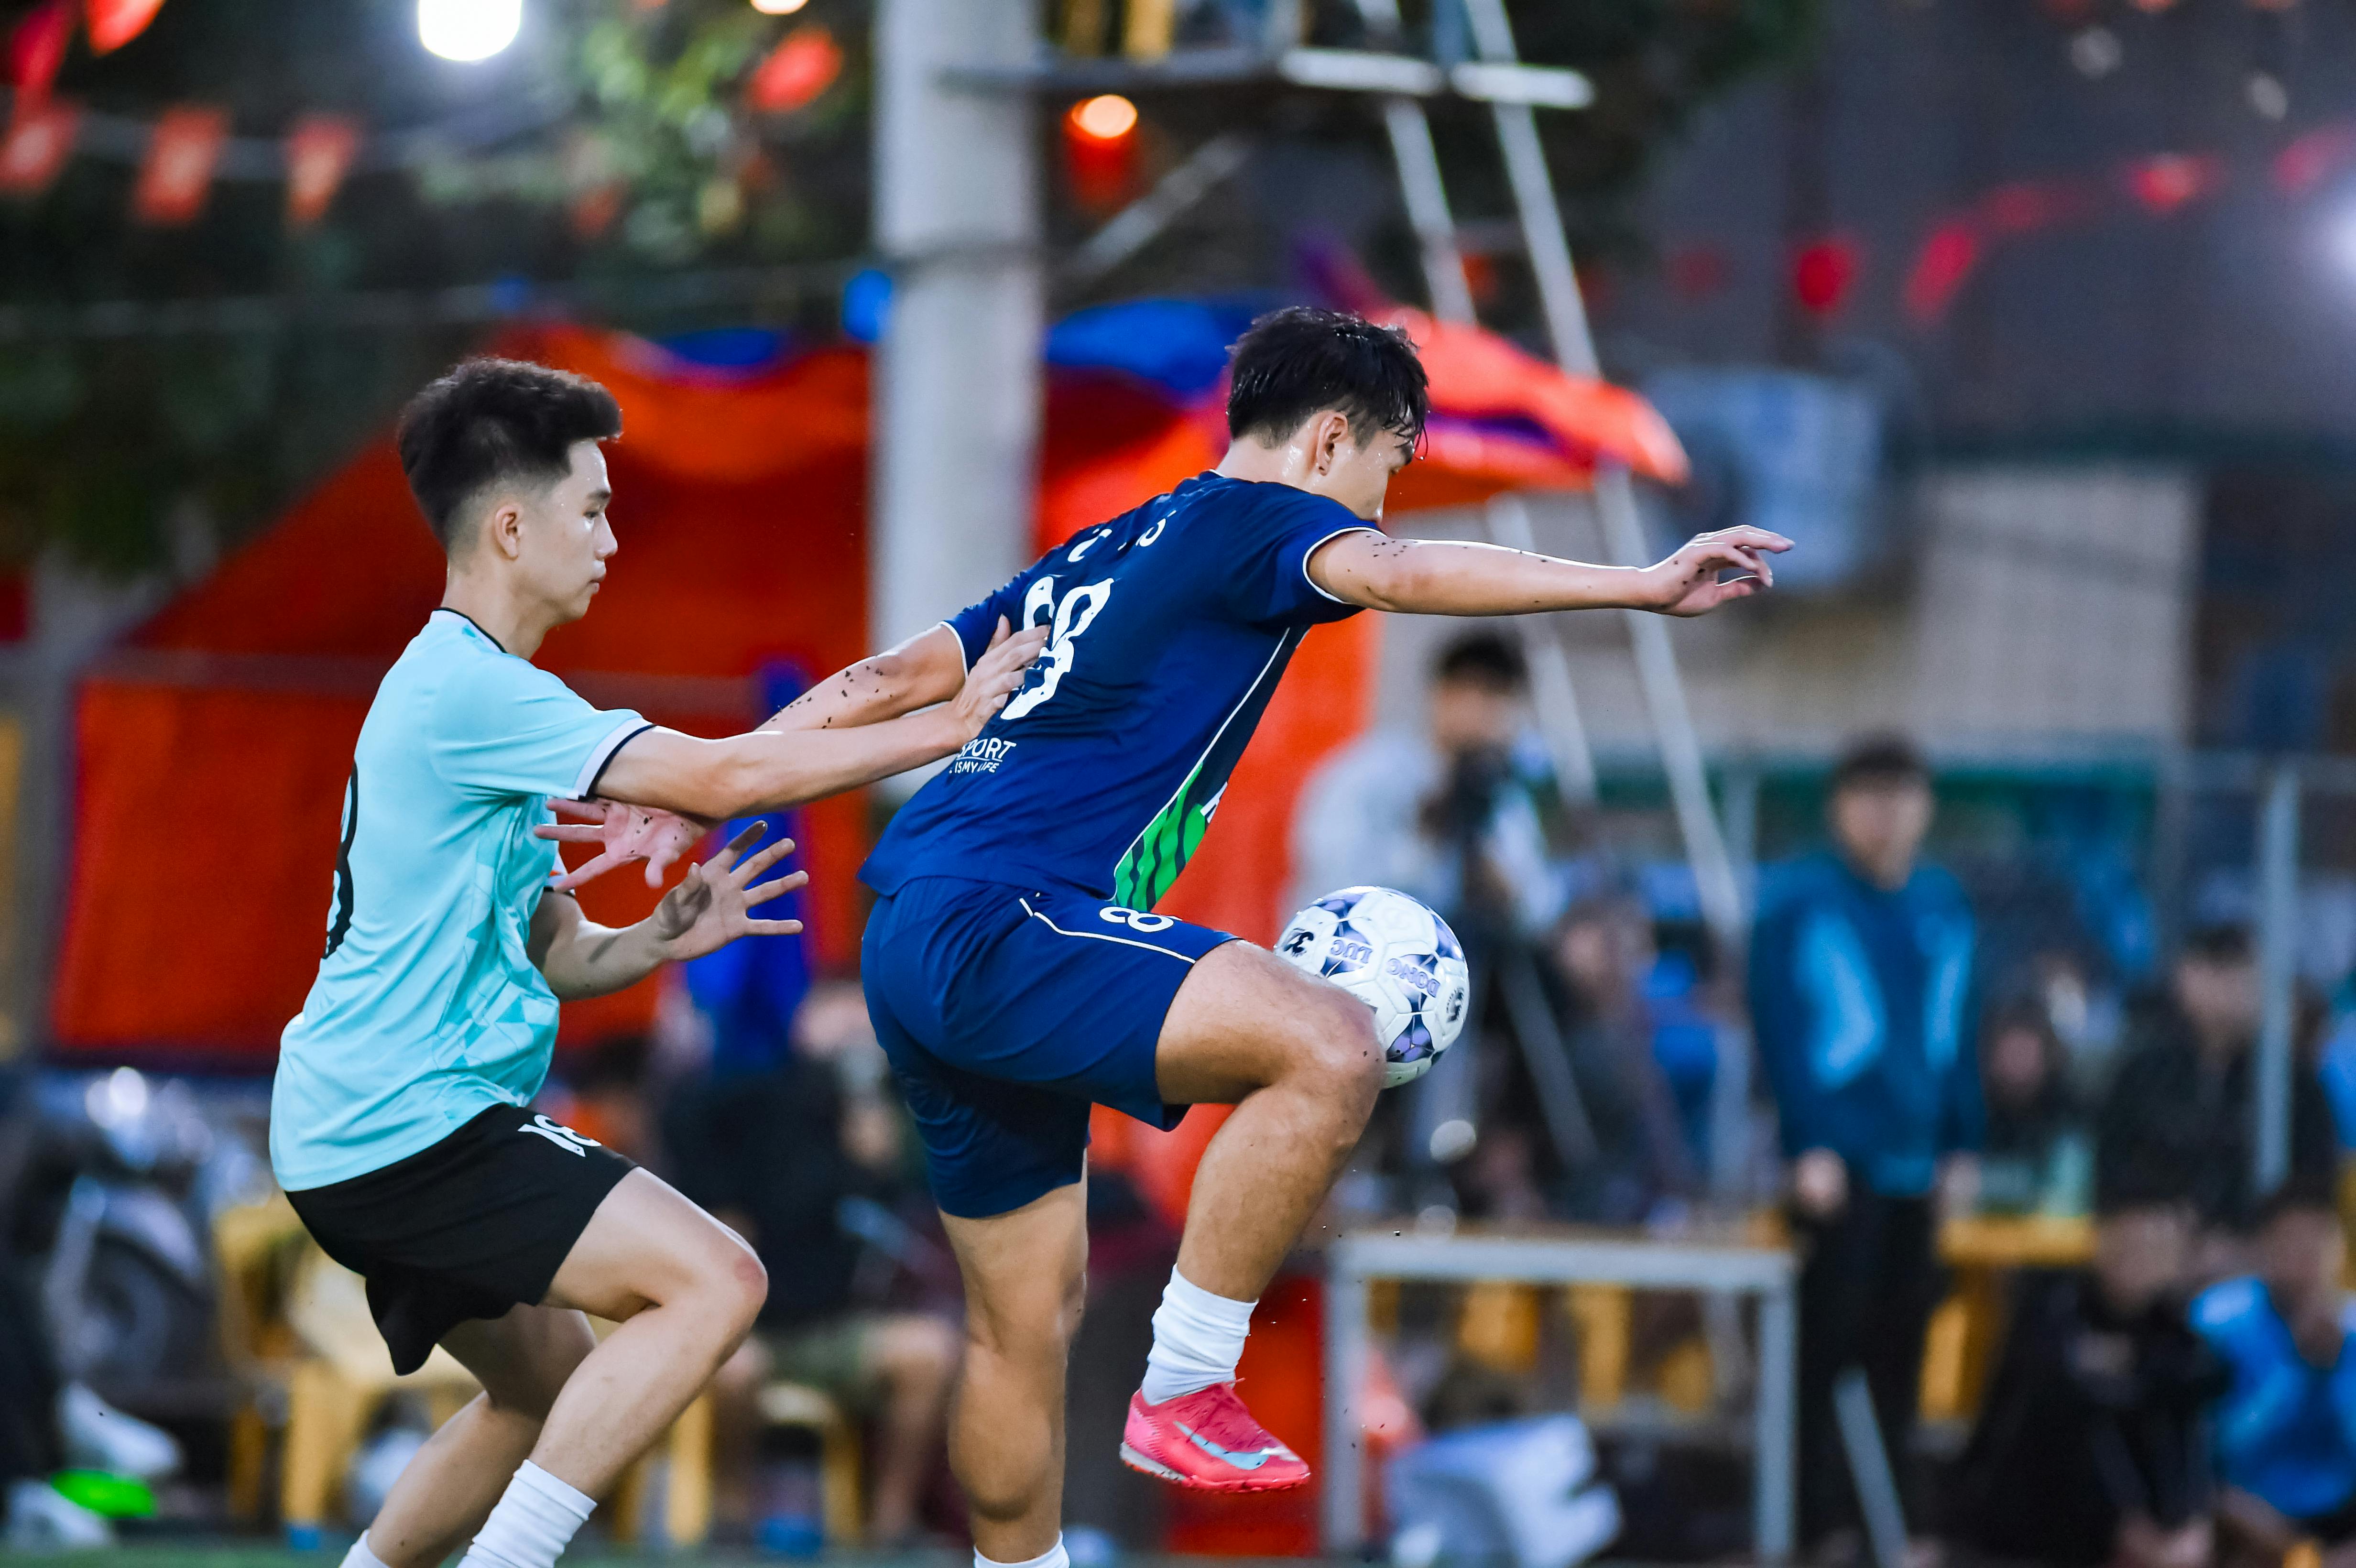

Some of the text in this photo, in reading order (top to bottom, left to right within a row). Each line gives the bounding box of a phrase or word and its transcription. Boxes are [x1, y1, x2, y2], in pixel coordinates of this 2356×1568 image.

[957, 737, 1017, 759] SPORT
[1331, 939, 1373, 964] LUC
[517, 1114, 602, 1157] 18
